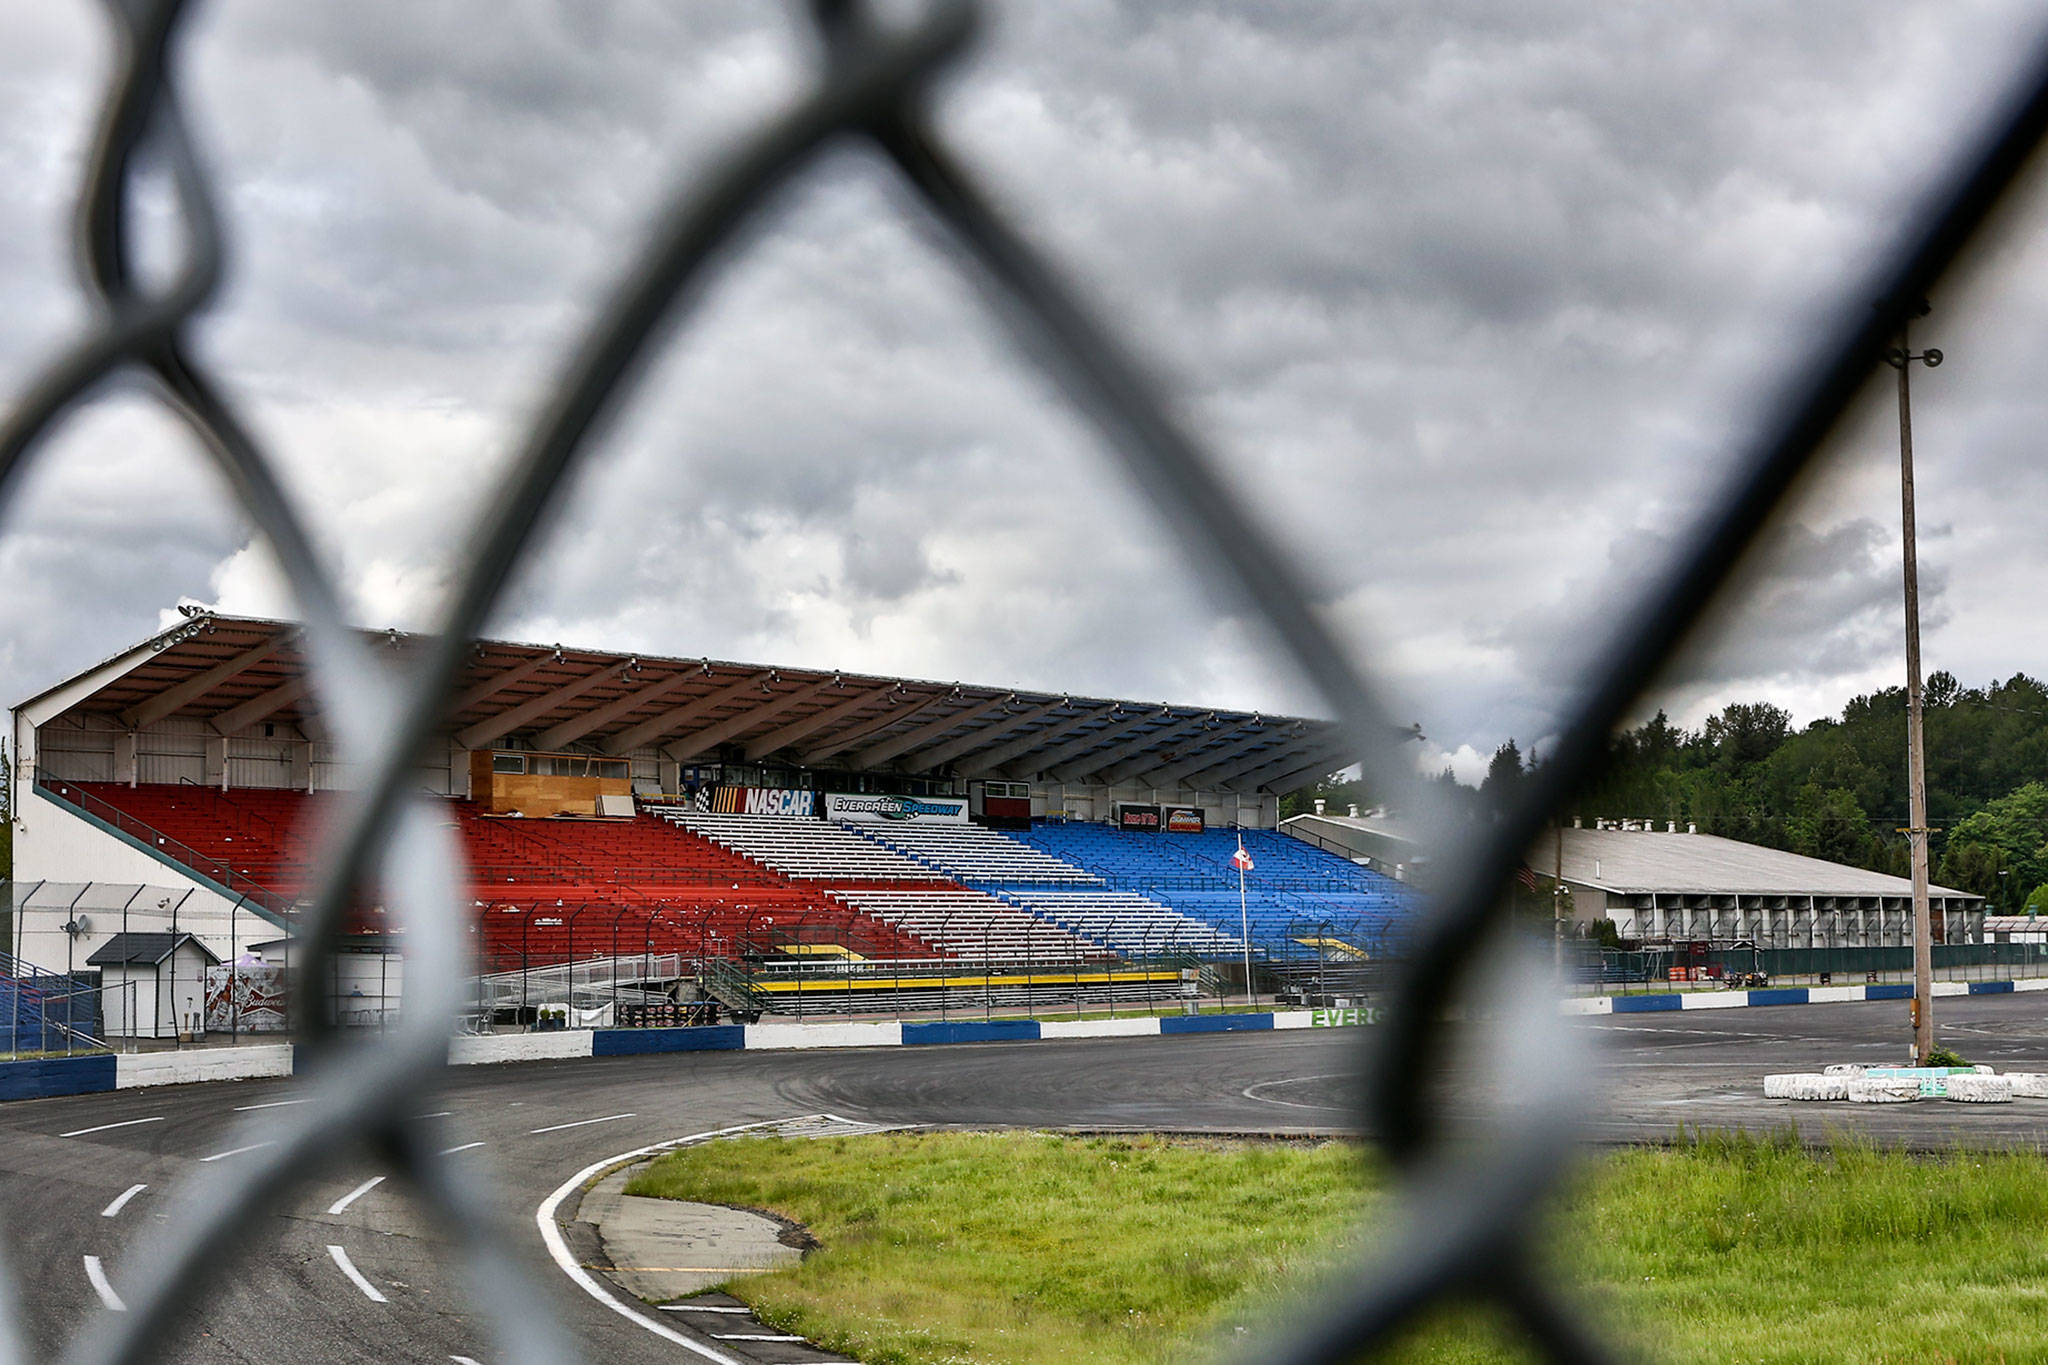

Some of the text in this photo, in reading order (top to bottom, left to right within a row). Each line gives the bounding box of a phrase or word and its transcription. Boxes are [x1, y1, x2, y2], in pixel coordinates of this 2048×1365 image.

[744, 788, 812, 815] NASCAR
[834, 798, 962, 816] EVERGREEN SPEEDWAY
[1311, 1008, 1388, 1028] EVERG
